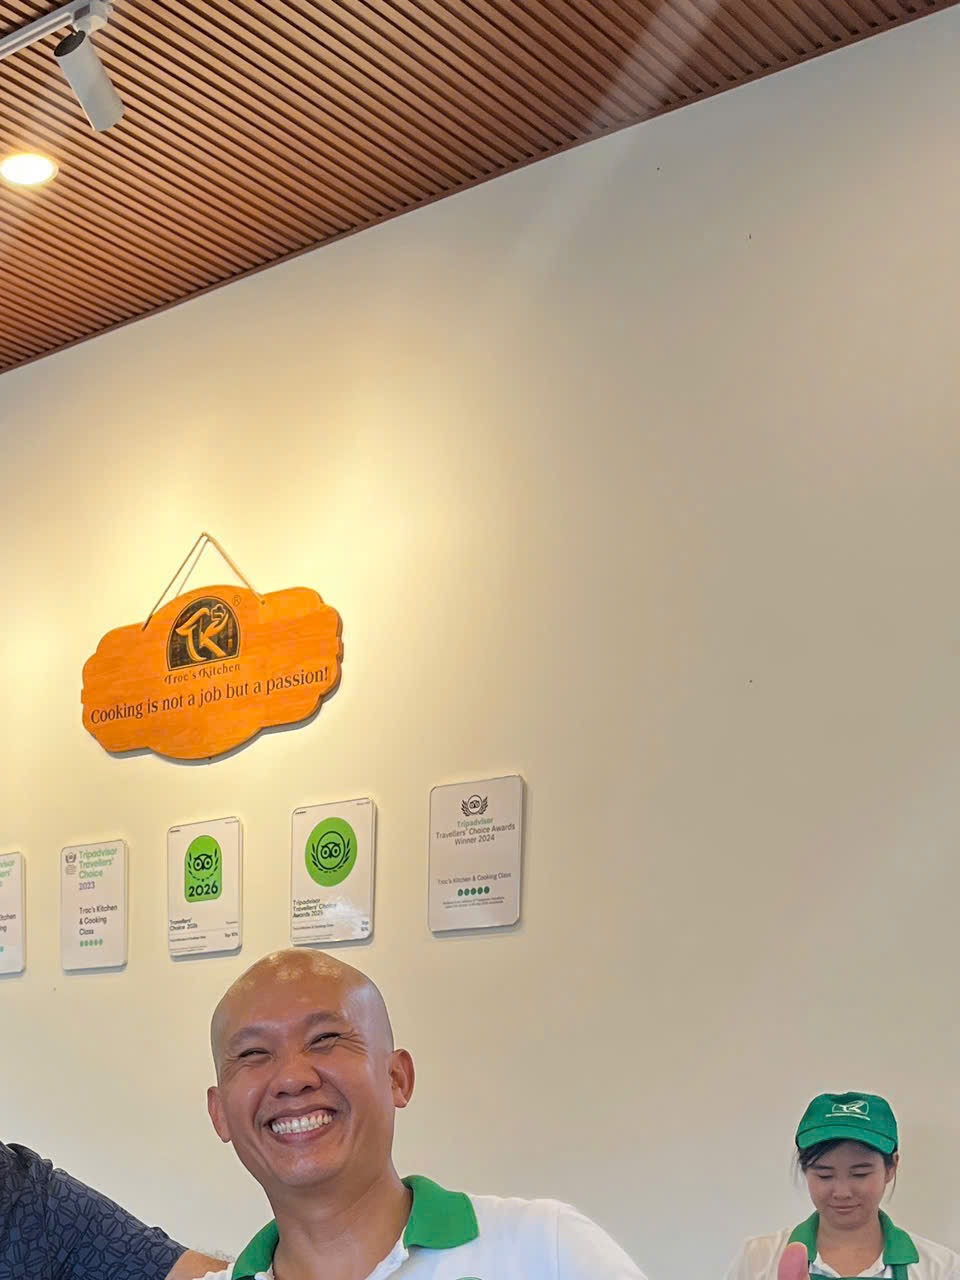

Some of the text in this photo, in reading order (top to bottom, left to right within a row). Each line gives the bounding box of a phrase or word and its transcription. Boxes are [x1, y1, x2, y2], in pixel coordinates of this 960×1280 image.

[198, 663, 240, 679] Kitchen
[90, 666, 329, 724] Cooking is not a job but a passion!
[468, 827, 490, 835] Choice
[491, 823, 516, 832] Awards
[455, 834, 495, 845] Winner 2024
[79, 870, 103, 879] Choice
[188, 880, 218, 897] 2026
[96, 904, 118, 912] Kitchen
[84, 916, 107, 924] Cooking
